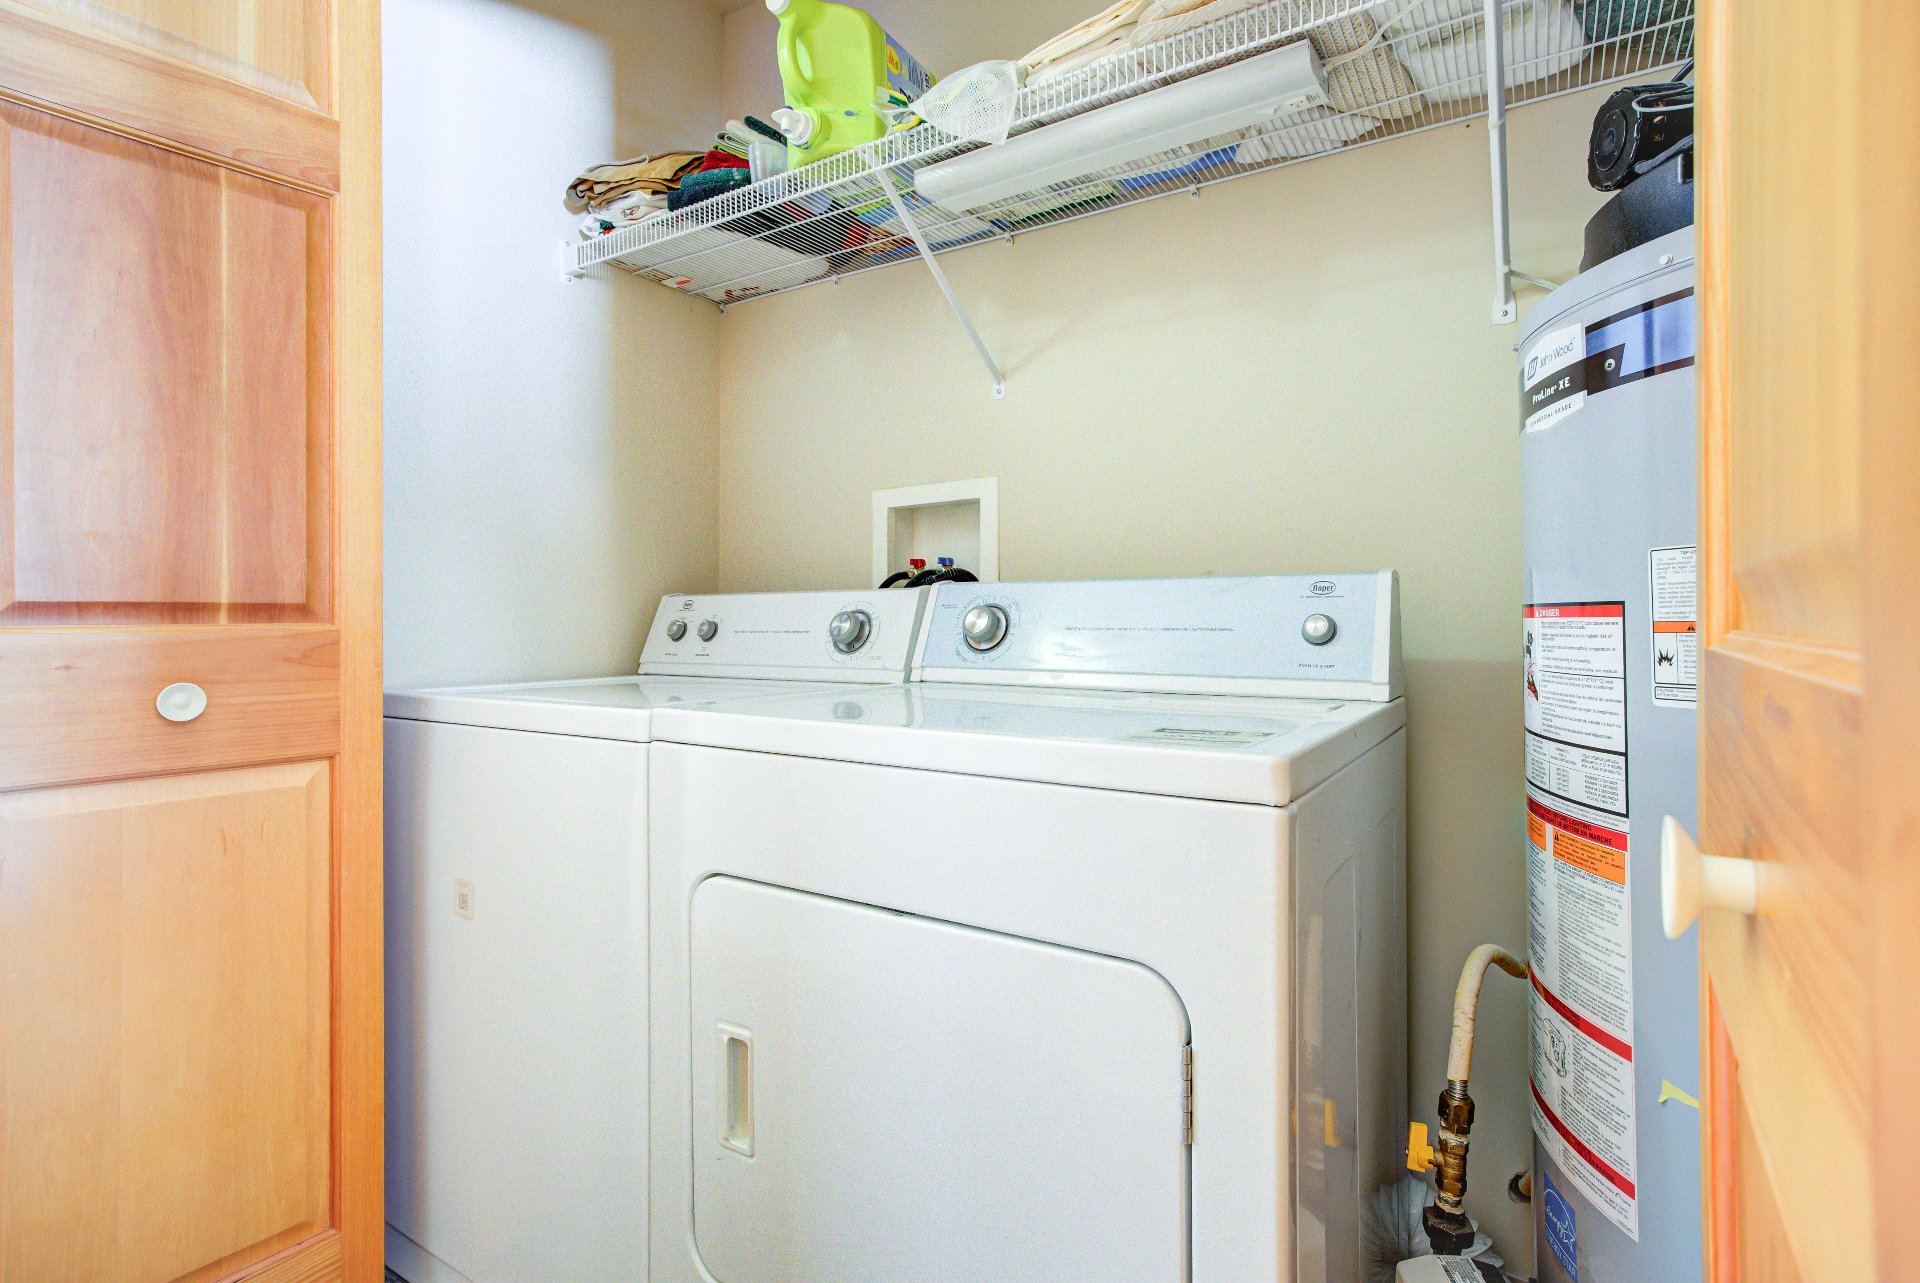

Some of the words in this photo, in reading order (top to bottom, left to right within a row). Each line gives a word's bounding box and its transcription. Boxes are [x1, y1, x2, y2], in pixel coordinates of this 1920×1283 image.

[1540, 353, 1553, 369] John
[1553, 338, 1574, 360] Wood
[1558, 377, 1570, 390] XE
[1555, 402, 1572, 415] GRADE
[1312, 584, 1334, 593] Roper
[1539, 608, 1560, 617] DANGER
[1568, 817, 1592, 832] LIGHTING
[1563, 823, 1580, 835] METTRE
[1581, 829, 1588, 838] EN
[1588, 832, 1613, 846] MARCHE
